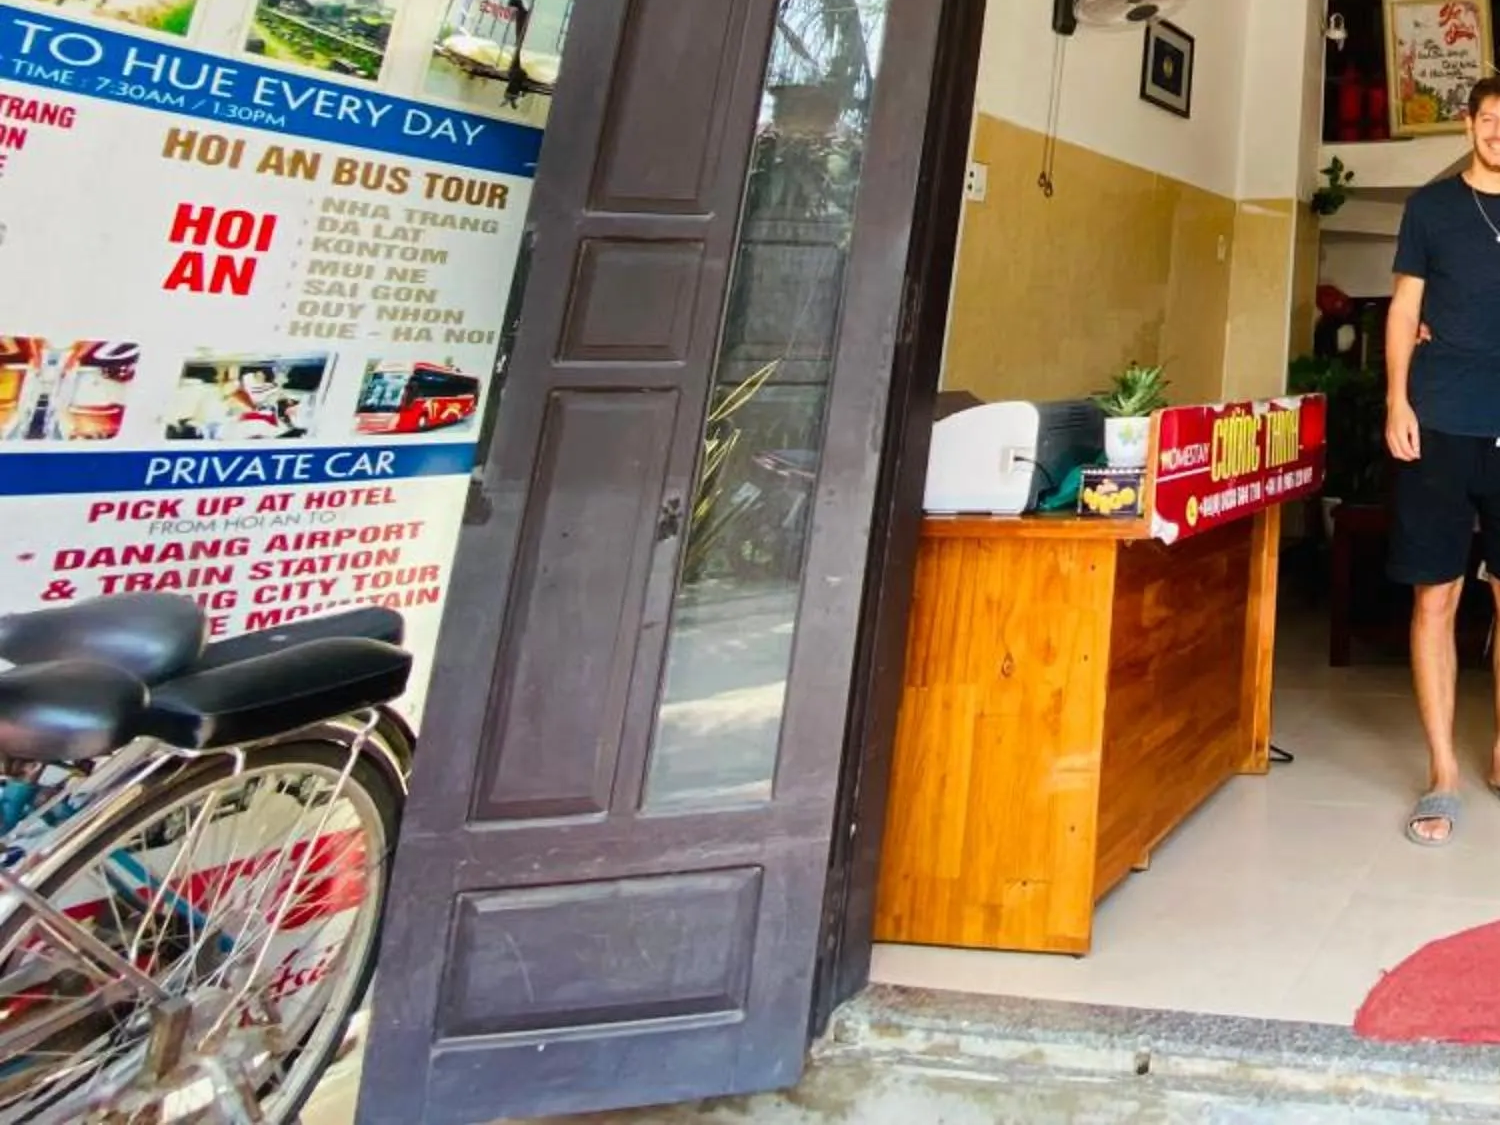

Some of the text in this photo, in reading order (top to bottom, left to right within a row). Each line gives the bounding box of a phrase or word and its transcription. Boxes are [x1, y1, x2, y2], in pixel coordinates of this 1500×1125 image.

[12, 58, 75, 86] TIME
[13, 18, 485, 147] TO HUE EVERY DAY
[0, 93, 76, 129] TRANG
[161, 127, 509, 210] HOI AN BUS TOUR
[168, 202, 278, 253] HOI
[316, 216, 426, 244] DA LAT
[321, 197, 499, 235] NHA TRANG
[311, 236, 448, 265] KONTOM
[163, 251, 258, 296] AN
[307, 259, 428, 284] MUI NE
[303, 279, 439, 304] SAI GON
[376, 304, 465, 325] NHON
[288, 321, 358, 340] HUE
[392, 326, 433, 343] HA
[444, 329, 495, 345] NOI
[144, 450, 396, 486] PRIVATE CAR
[88, 486, 397, 523] PICK UP AT HOTEL
[149, 510, 338, 536] FROM HOI AN TO
[53, 537, 250, 571] DANANG
[264, 521, 425, 553] AIRPORT
[41, 547, 401, 601] & TRAIN STATION
[253, 577, 338, 605] CITY
[351, 565, 441, 593] TOUR
